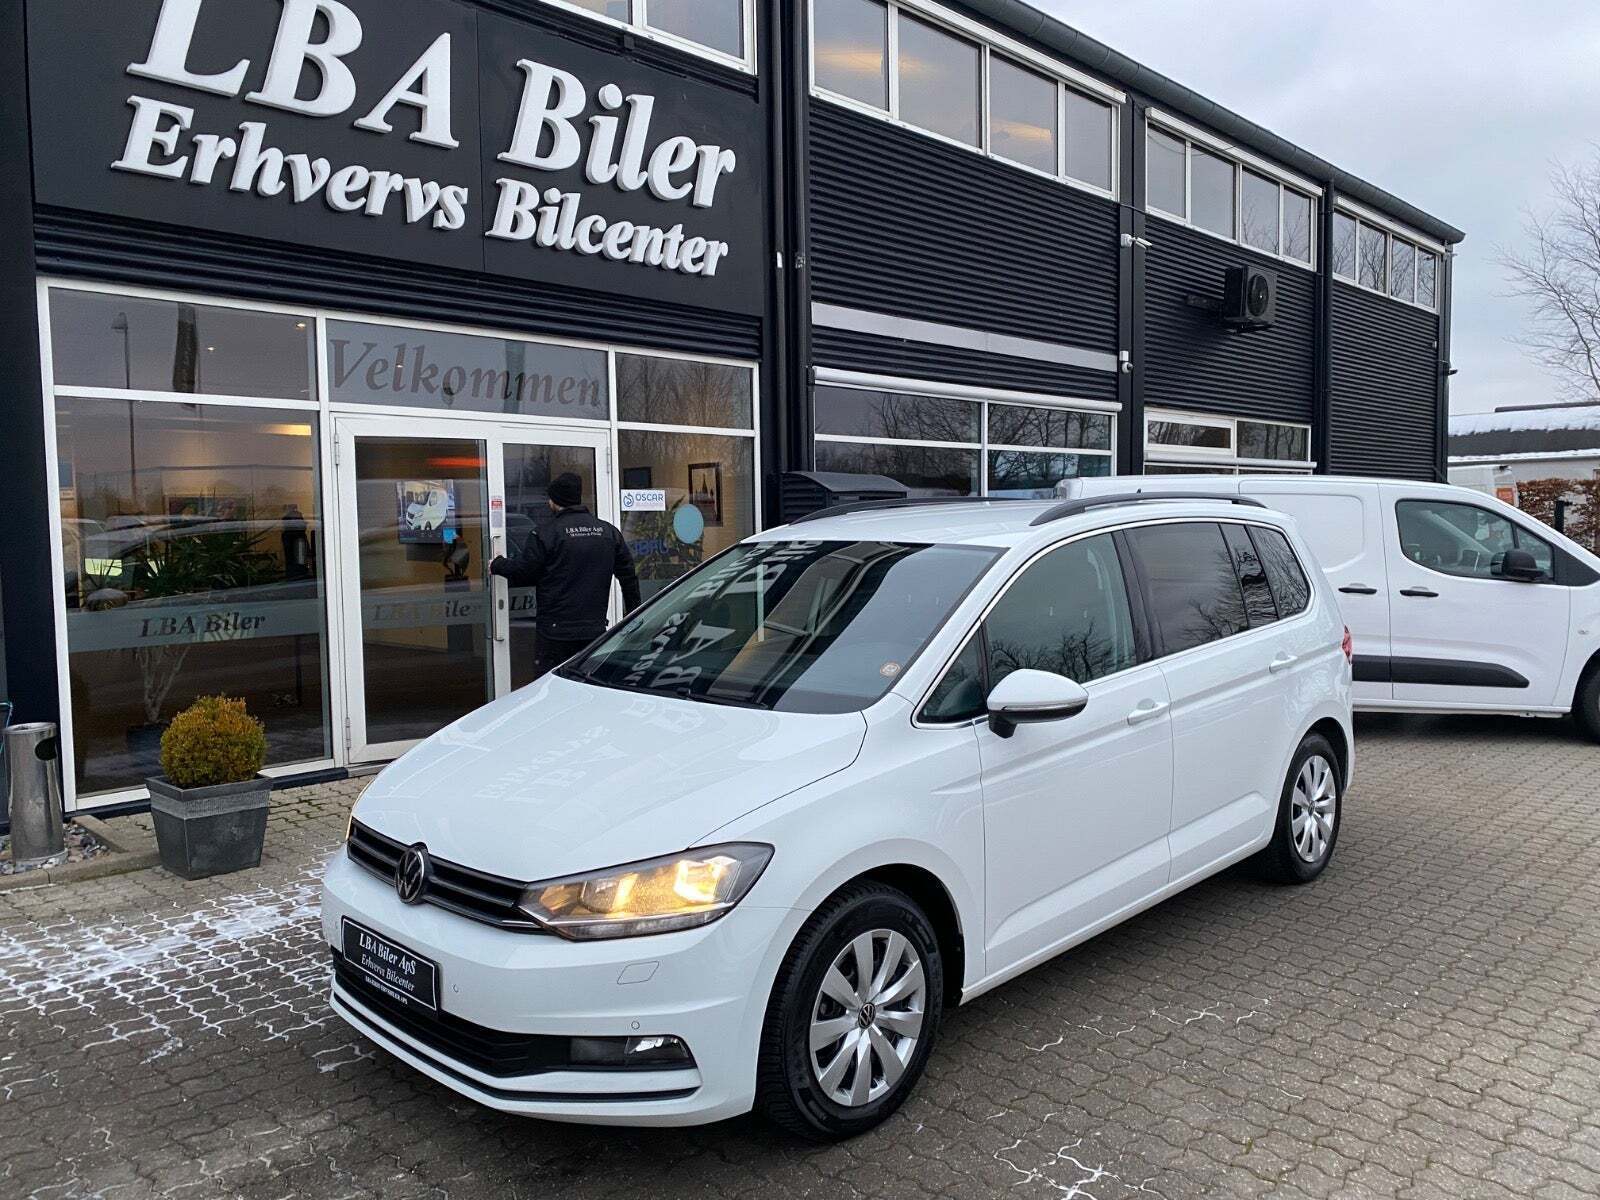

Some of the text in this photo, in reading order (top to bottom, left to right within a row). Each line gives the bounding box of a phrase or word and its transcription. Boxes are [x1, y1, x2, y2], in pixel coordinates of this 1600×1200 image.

[126, 0, 736, 208] LBA Biler
[110, 95, 729, 276] Erhvervs Bilcenter
[329, 338, 601, 408] Velkommen
[635, 493, 664, 502] OSCAR
[138, 611, 266, 637] LBA Biler
[359, 932, 417, 976] LBA Biler ApS
[385, 967, 416, 993] Bilcenter
